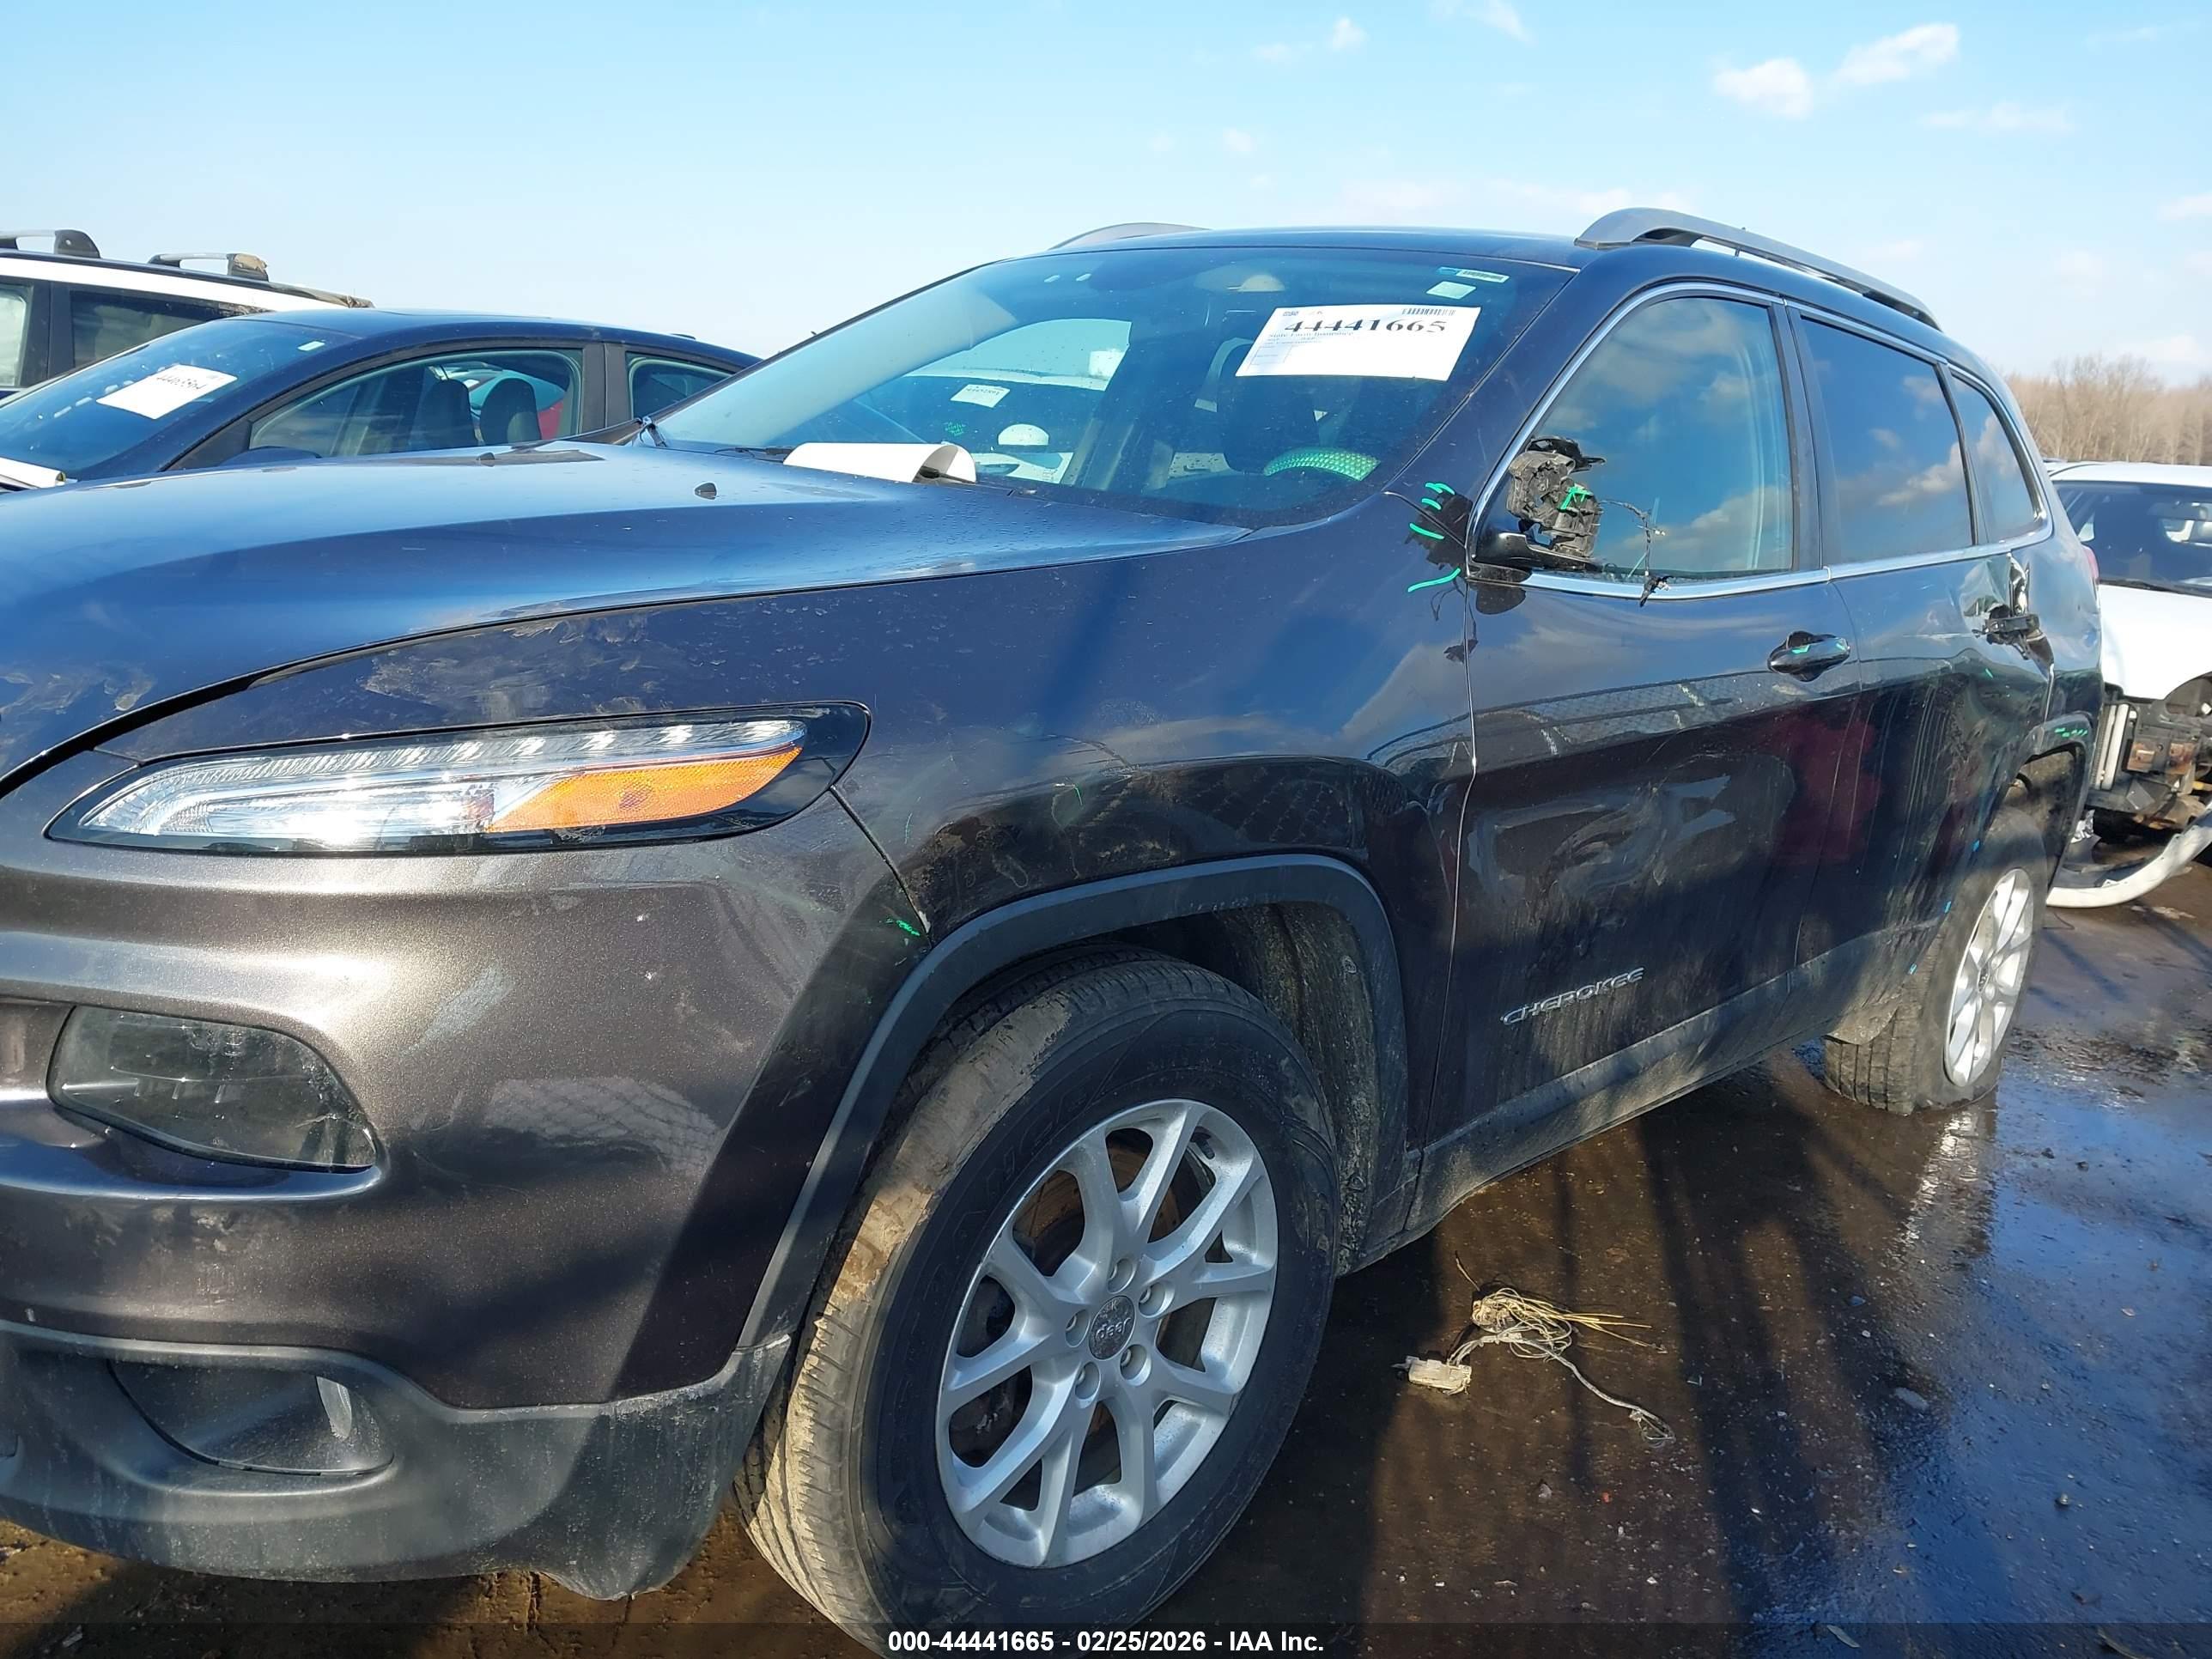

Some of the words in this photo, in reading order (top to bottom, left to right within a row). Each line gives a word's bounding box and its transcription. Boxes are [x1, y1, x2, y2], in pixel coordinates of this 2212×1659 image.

[1284, 319, 1448, 332] 44441665
[1500, 967, 1644, 1025] CHEROKEE
[1095, 1317, 1131, 1340] Jeep
